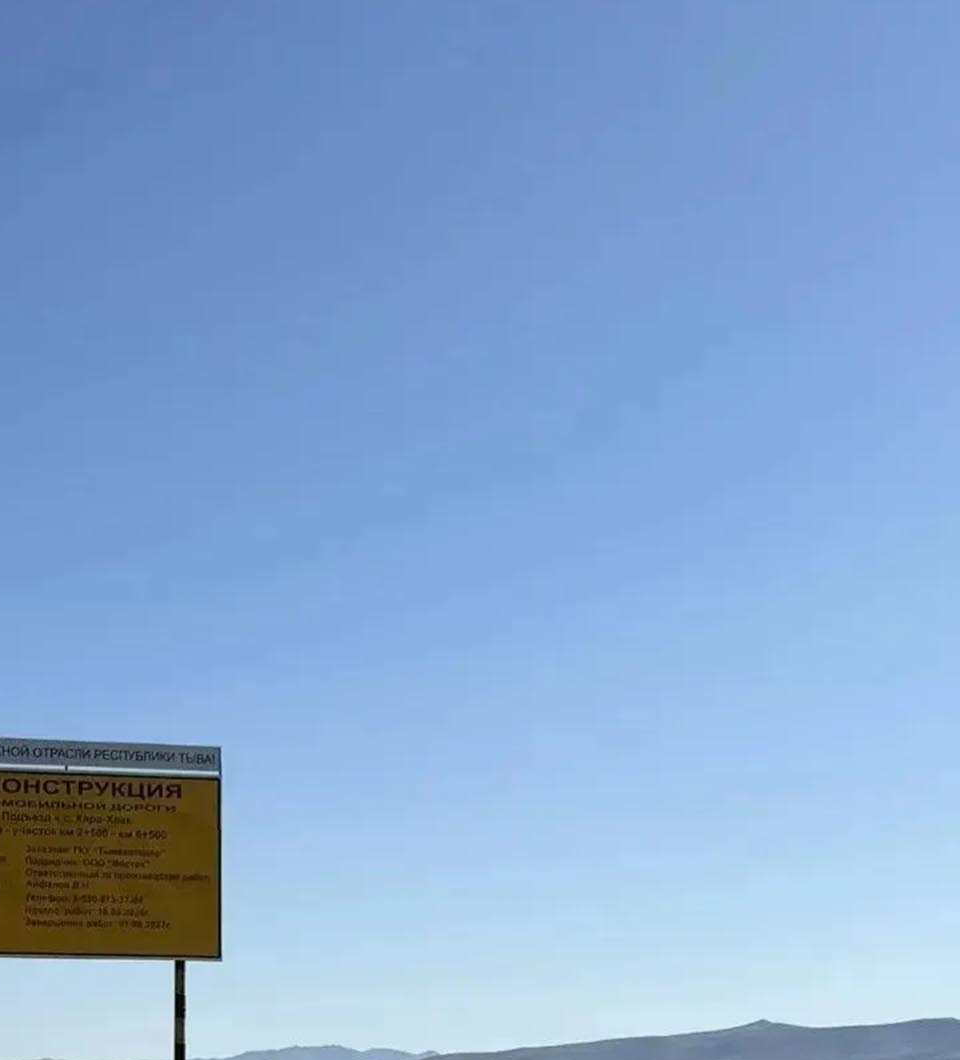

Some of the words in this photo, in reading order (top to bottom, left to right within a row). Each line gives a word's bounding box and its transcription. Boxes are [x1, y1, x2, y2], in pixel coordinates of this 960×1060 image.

[33, 746, 90, 760] ОТРАСЛИ
[94, 749, 175, 763] РЕСПУБЛИКИ
[178, 752, 215, 765] ТЫВА!
[109, 803, 177, 813] ДОРОГИ
